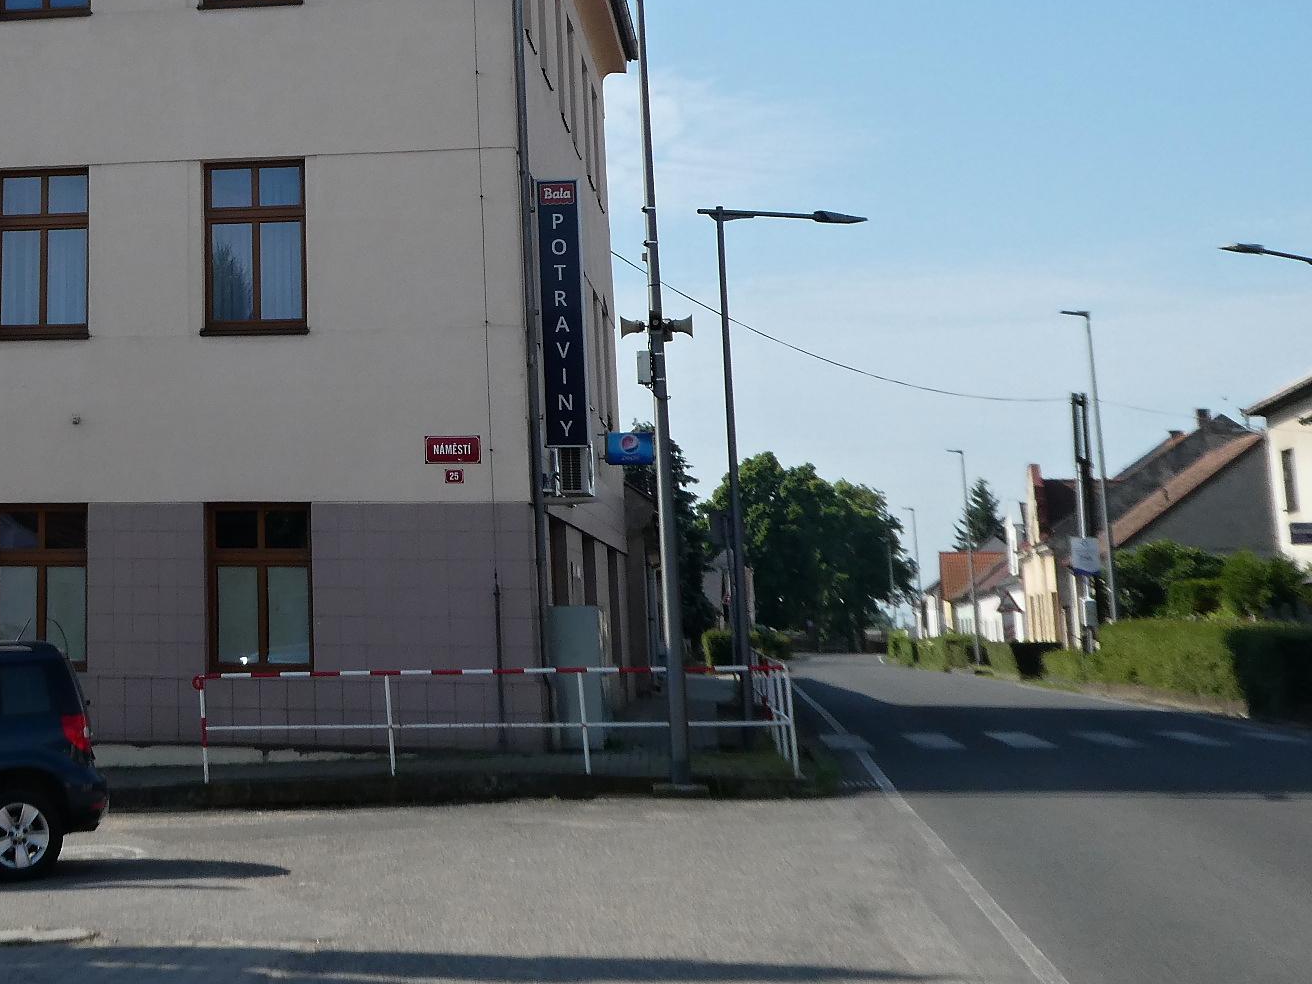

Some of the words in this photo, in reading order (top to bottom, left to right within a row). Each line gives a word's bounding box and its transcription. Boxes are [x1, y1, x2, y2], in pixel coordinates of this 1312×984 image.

[543, 187, 571, 199] Bala
[551, 213, 573, 437] POTRAVINY
[433, 442, 472, 455] NÁMĚSTÍ
[449, 472, 459, 481] 25
